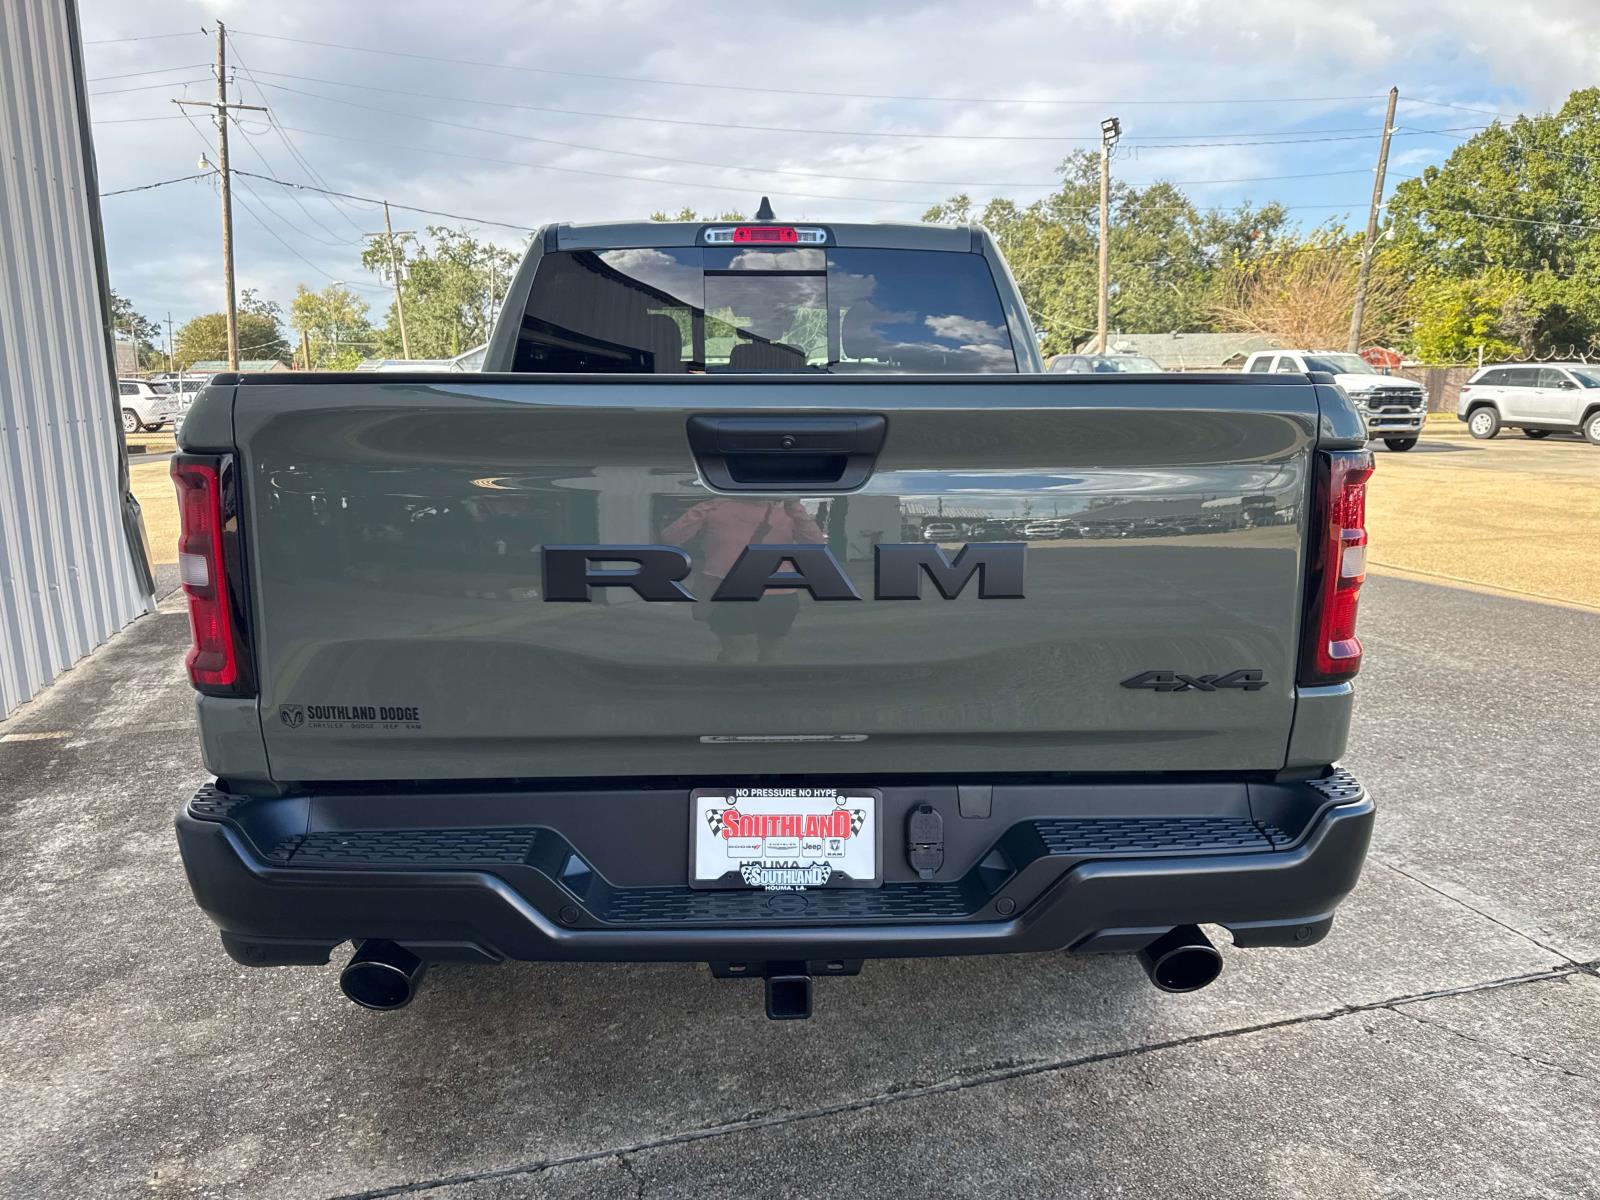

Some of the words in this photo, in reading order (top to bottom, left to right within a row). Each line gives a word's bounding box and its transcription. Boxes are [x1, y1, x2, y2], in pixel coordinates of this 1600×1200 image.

[541, 543, 1027, 602] RAM
[1120, 669, 1269, 692] 4x4
[307, 705, 376, 720] SOUTHLAND
[379, 706, 420, 721] DODGE
[735, 788, 749, 797] NO
[751, 788, 797, 797] PRESSURE
[798, 788, 811, 797] NO
[814, 788, 837, 797] HYPE
[722, 810, 852, 839] SOUTHLAND
[803, 843, 822, 852] Jeep
